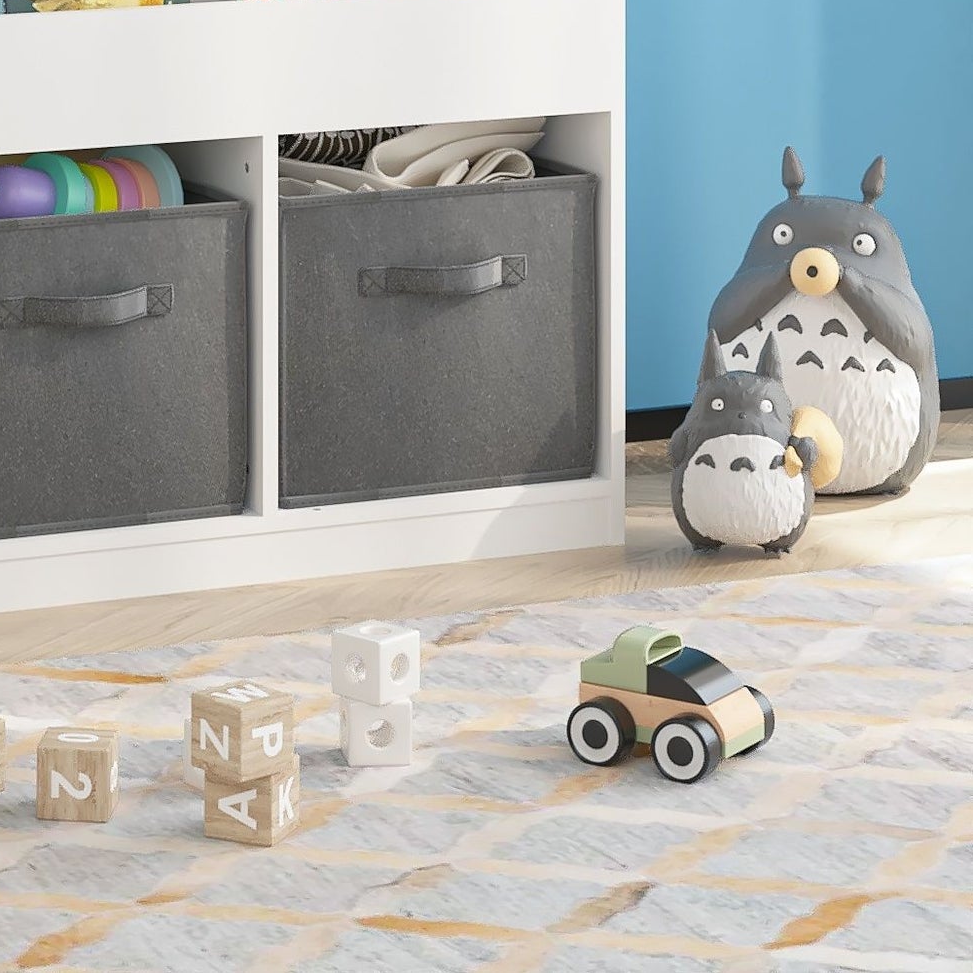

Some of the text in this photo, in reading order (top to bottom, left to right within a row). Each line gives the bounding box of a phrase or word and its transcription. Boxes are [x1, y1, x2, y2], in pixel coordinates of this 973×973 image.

[251, 721, 284, 758] P
[50, 770, 92, 800] 2
[278, 776, 295, 827] K
[217, 789, 258, 830] A
